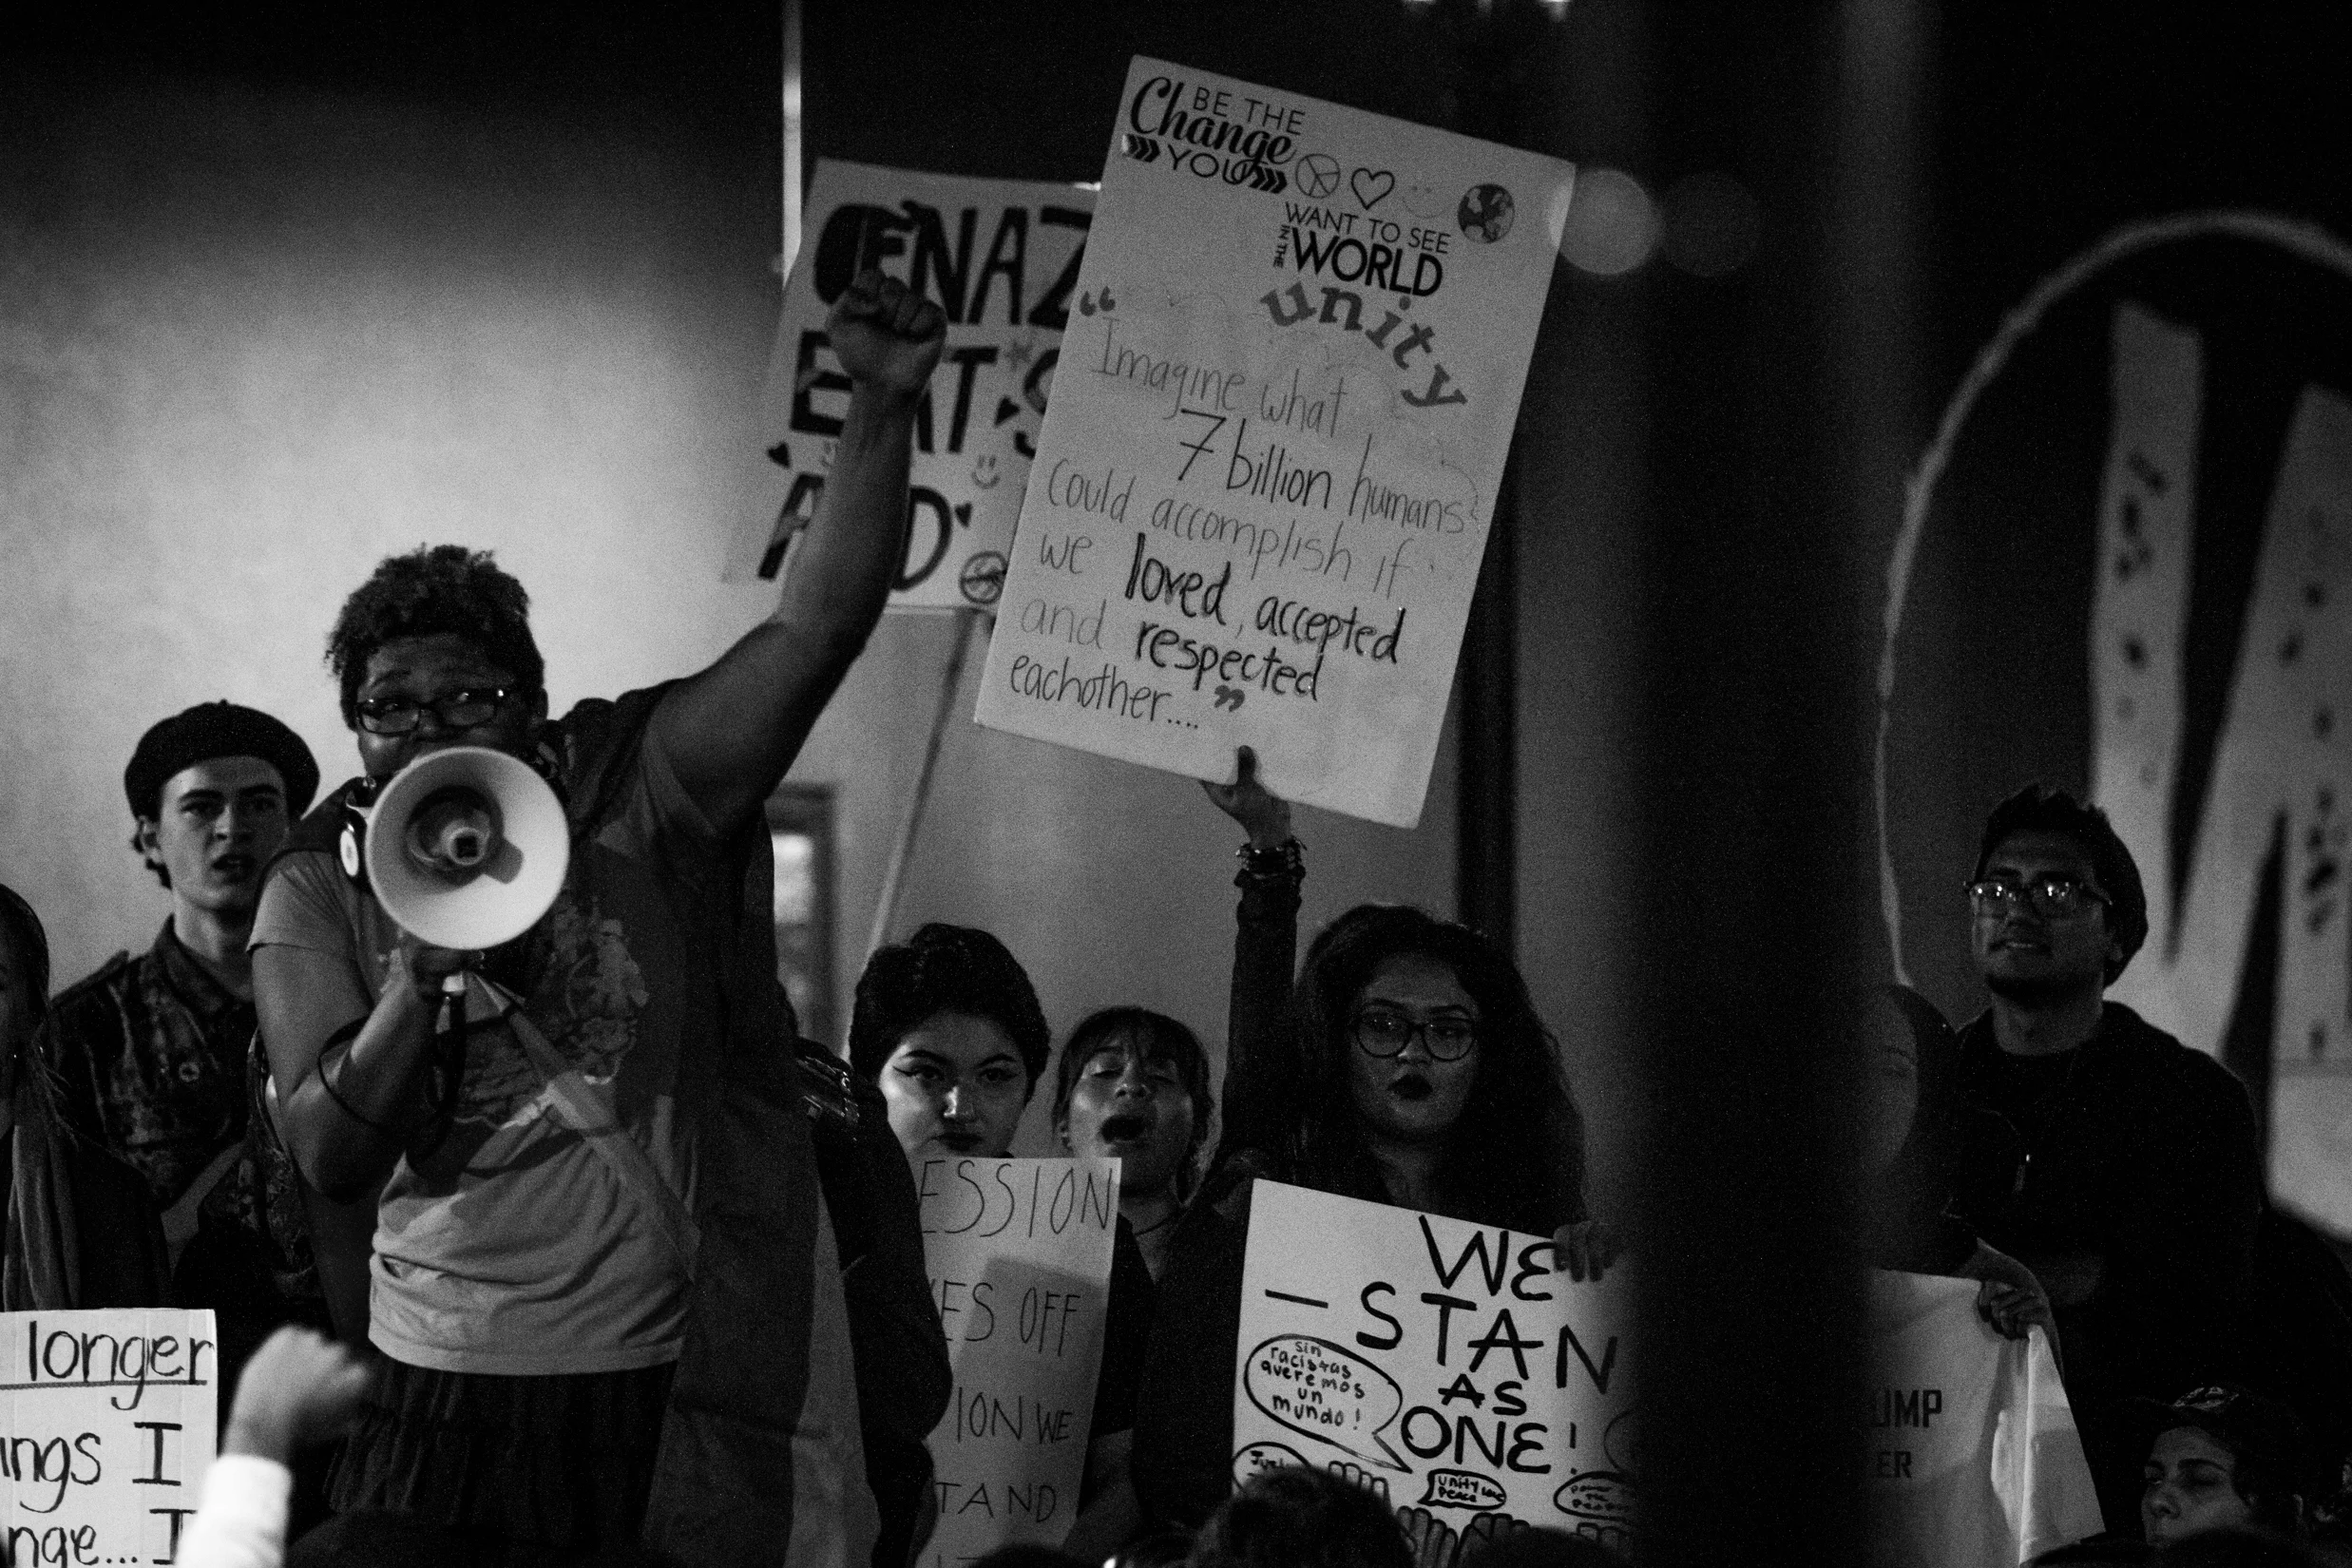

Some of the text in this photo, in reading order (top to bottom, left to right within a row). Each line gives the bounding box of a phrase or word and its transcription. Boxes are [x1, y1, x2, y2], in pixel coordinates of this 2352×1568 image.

[1129, 76, 1297, 171] Change
[1193, 86, 1307, 136] BE THE
[1167, 143, 1252, 185] YOU
[1272, 224, 1292, 269] IN THE
[1284, 201, 1452, 255] WANT TO SEE
[1291, 225, 1444, 297] WORLD
[1090, 316, 1348, 437] Imagine what
[1260, 281, 1468, 409] unity
[1177, 409, 1464, 535] 7 billion humans
[1151, 496, 1353, 583] accomplish
[1373, 537, 1416, 601] if
[1041, 532, 1094, 575] we
[1255, 595, 1406, 665] accepted
[1020, 599, 1324, 701] and respected
[1418, 1214, 1558, 1303] WE
[1020, 1286, 1081, 1357] OFF
[28, 1320, 215, 1411] longer
[1297, 1386, 1324, 1405] un
[1437, 1372, 1529, 1418] AS
[132, 1421, 183, 1487] I
[1037, 1402, 1073, 1444] WE
